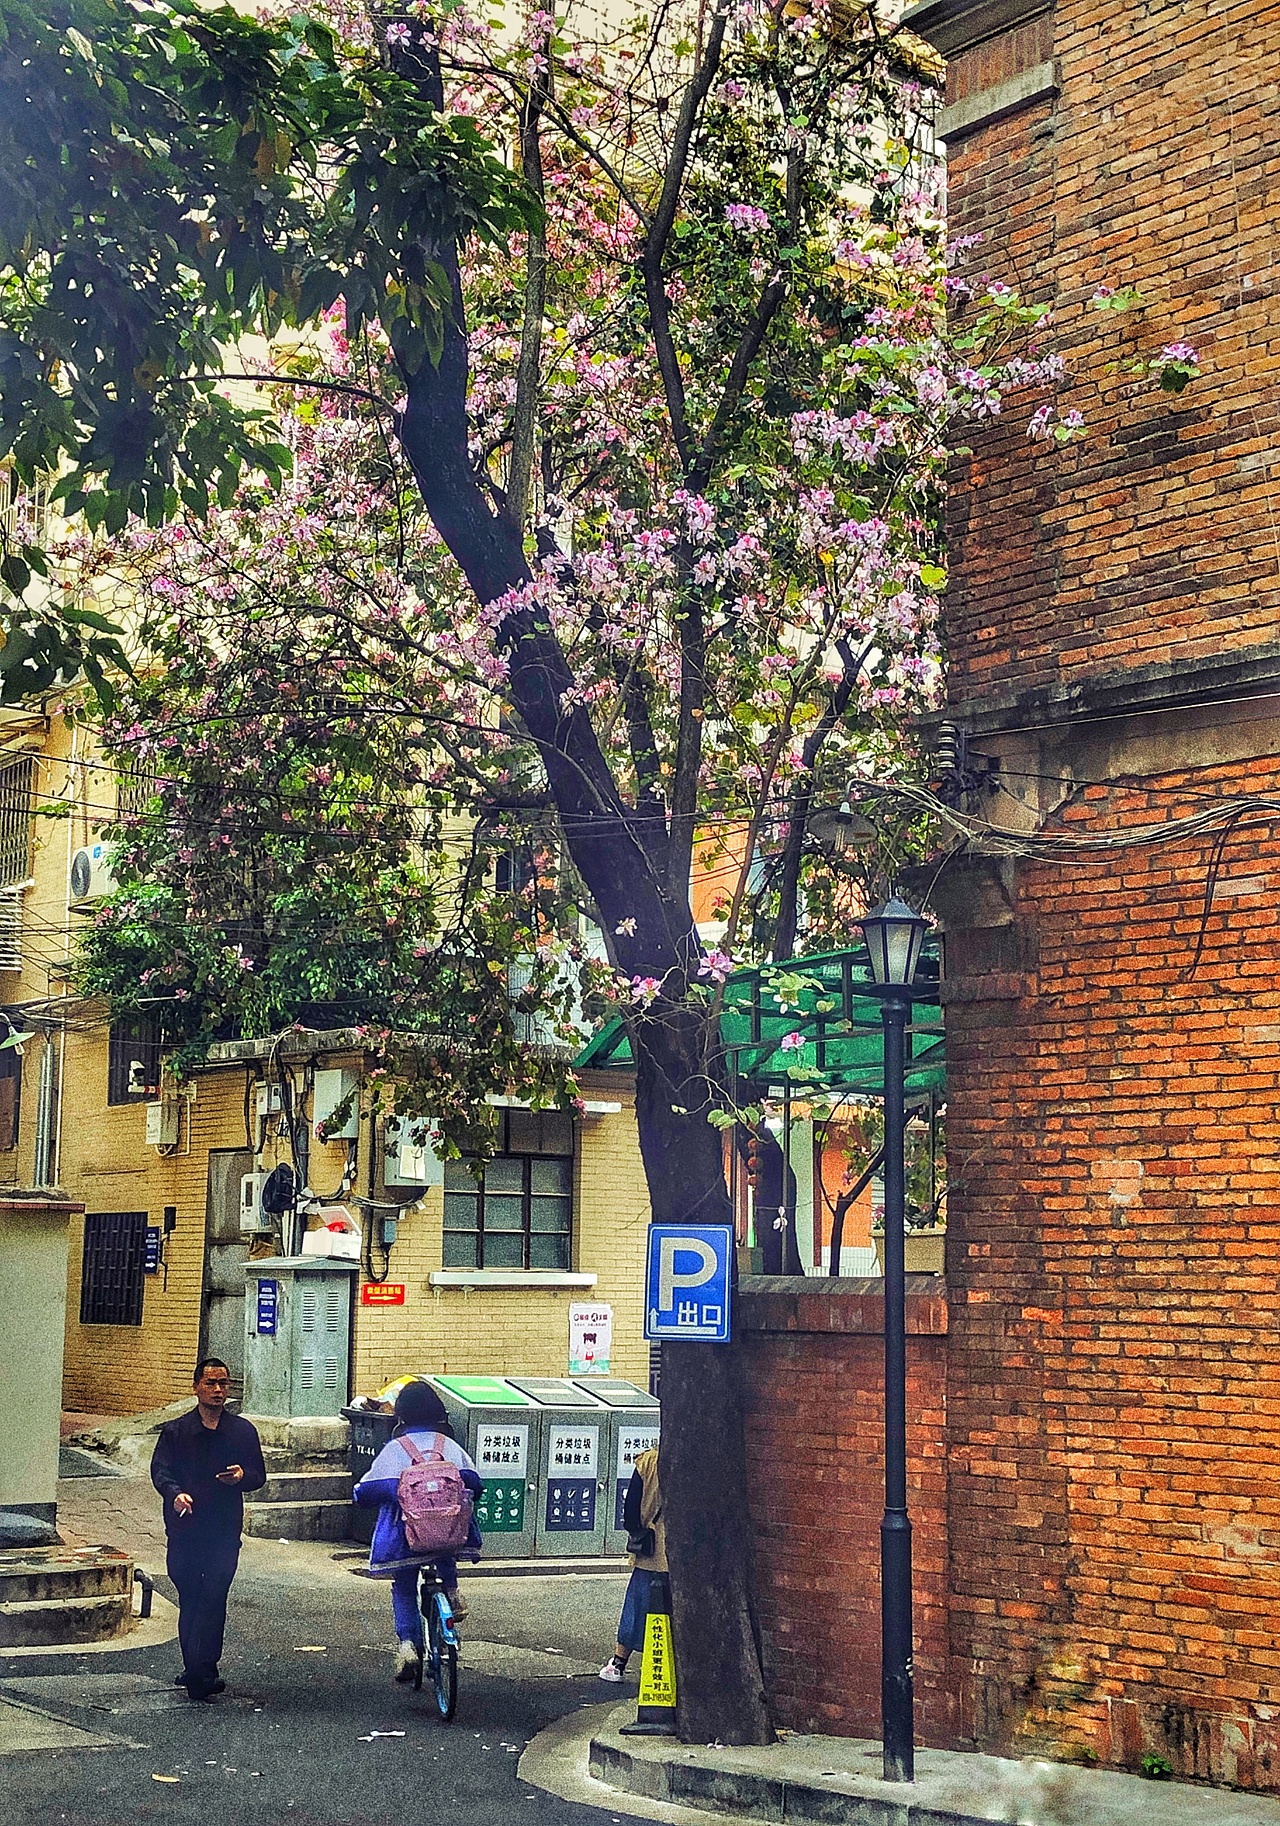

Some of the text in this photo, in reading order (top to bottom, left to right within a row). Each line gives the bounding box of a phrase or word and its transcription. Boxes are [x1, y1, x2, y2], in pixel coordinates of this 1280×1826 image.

[659, 1237, 718, 1311] P
[677, 1301, 721, 1326] 出口
[483, 1435, 521, 1447] 分类垃圾
[555, 1437, 592, 1449] 分类垃圾
[482, 1451, 520, 1463] 桶储放点
[555, 1453, 591, 1465] 桶储放点
[652, 1616, 663, 1681] 个性化小班更有效
